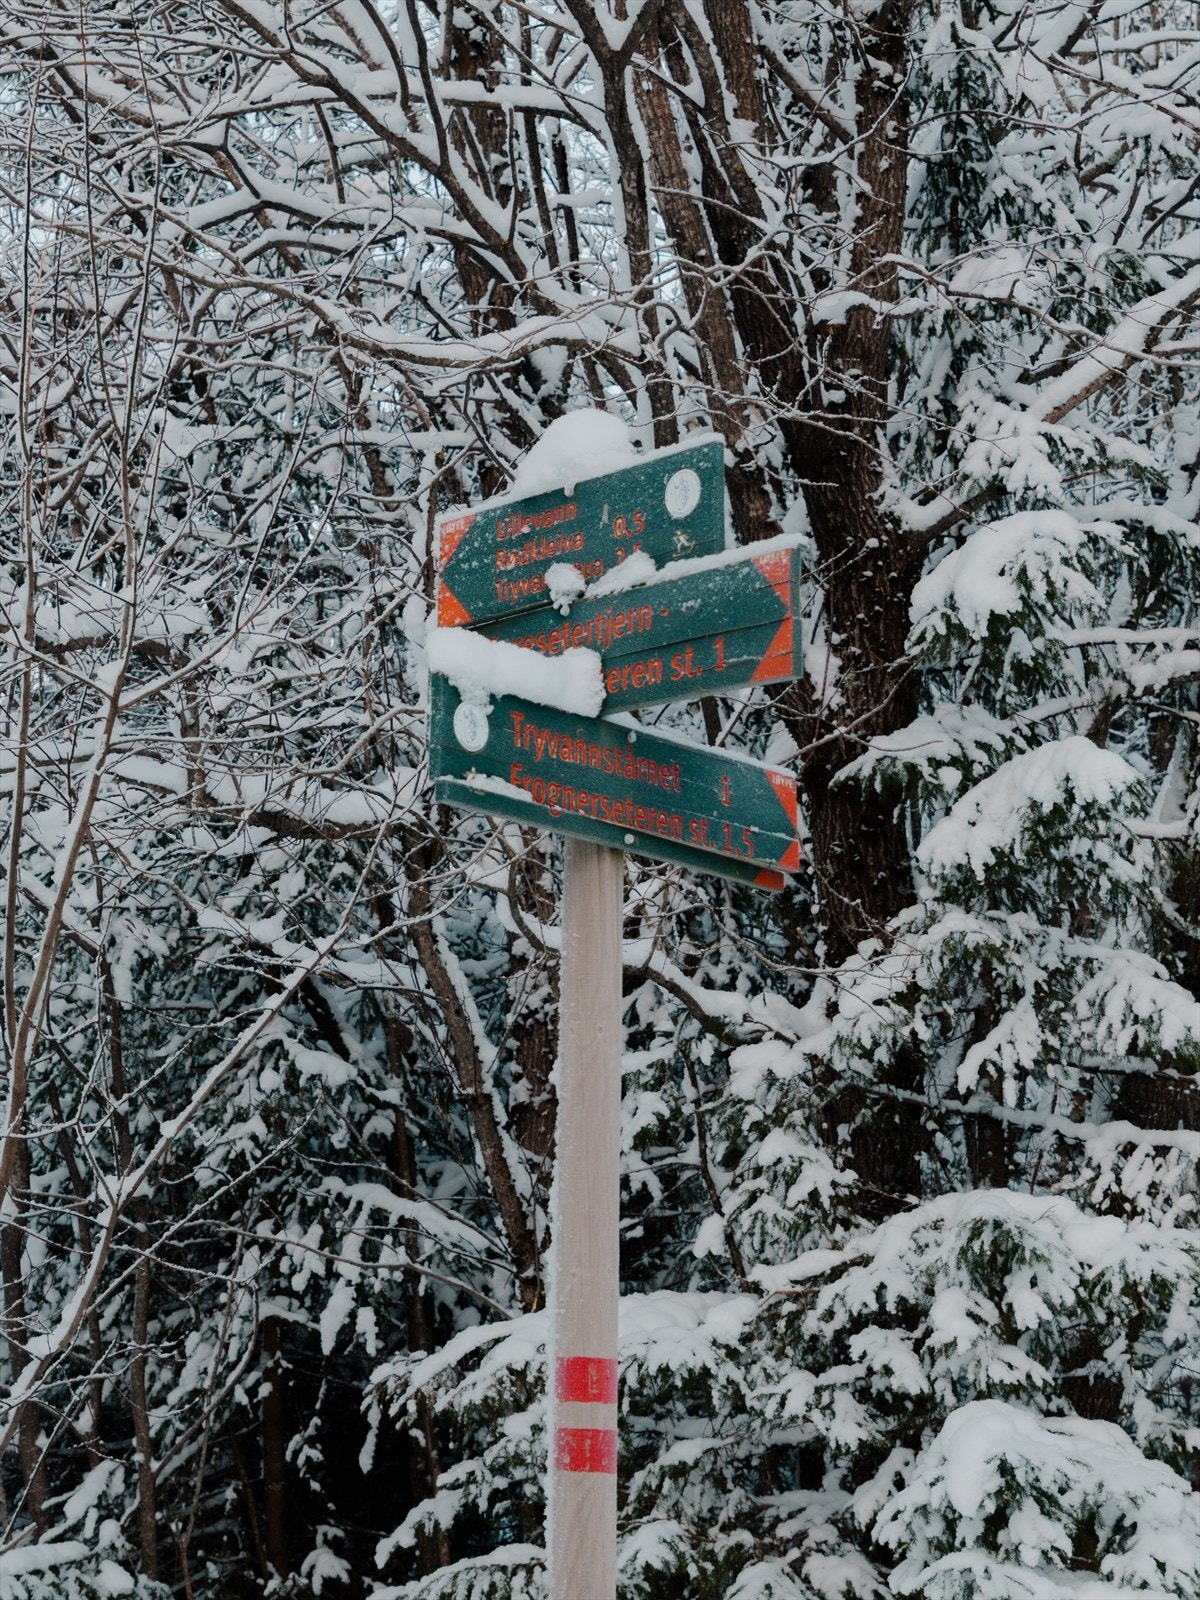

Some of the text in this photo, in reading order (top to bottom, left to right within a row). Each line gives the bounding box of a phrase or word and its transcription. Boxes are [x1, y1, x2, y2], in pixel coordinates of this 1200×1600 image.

[496, 502, 577, 541] Lillevann
[495, 532, 583, 572] Rødkleiva
[495, 559, 603, 606] Tryvaua
[489, 604, 652, 656] esetertjern
[671, 645, 703, 681] st.
[712, 636, 726, 671] 1
[510, 710, 681, 793] Tryvannstårnet
[510, 763, 682, 842] Frognerseteren
[771, 774, 795, 789] LØYPE
